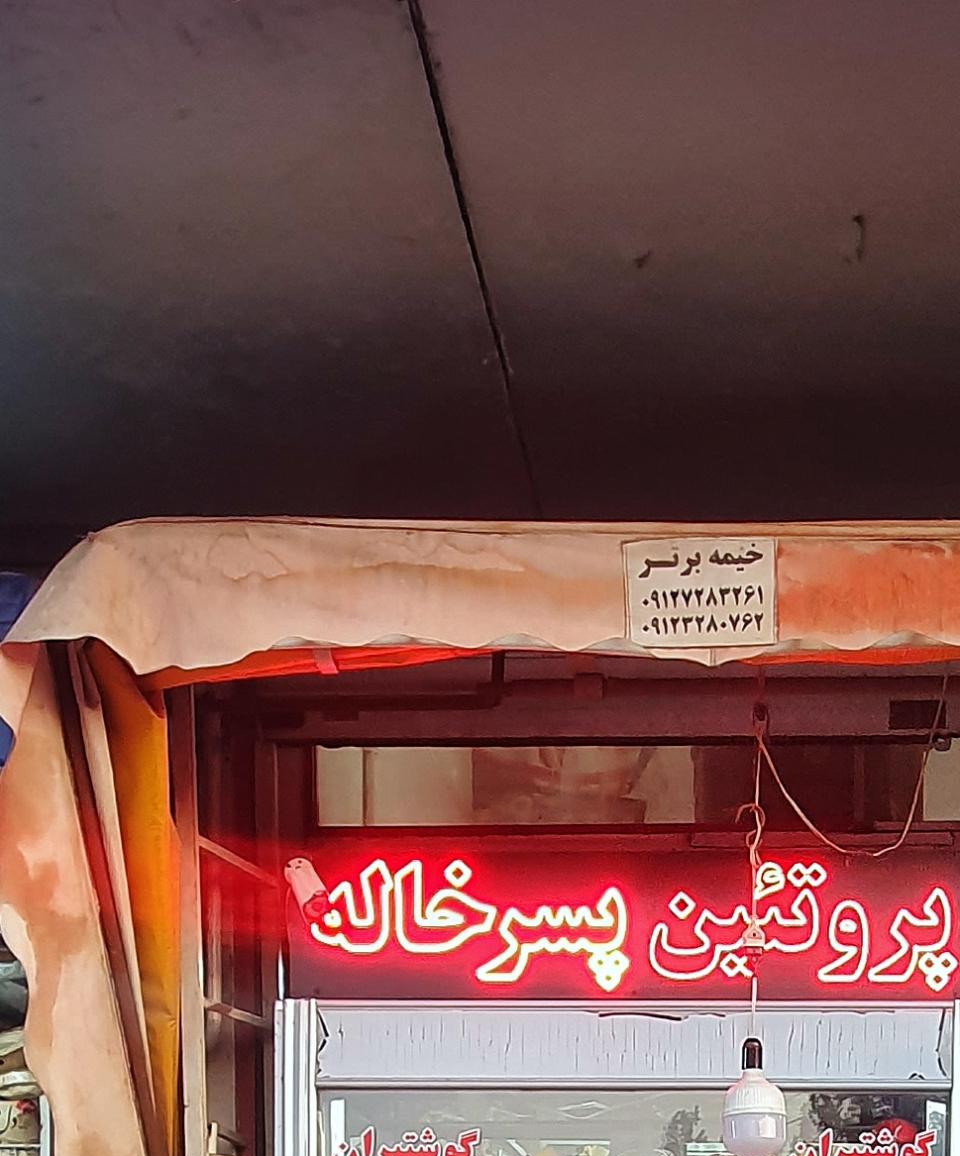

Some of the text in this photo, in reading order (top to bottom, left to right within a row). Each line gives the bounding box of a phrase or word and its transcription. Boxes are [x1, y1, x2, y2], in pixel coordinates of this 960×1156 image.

[638, 543, 764, 579] خیمه برتر
[649, 860, 959, 992] پروتئین
